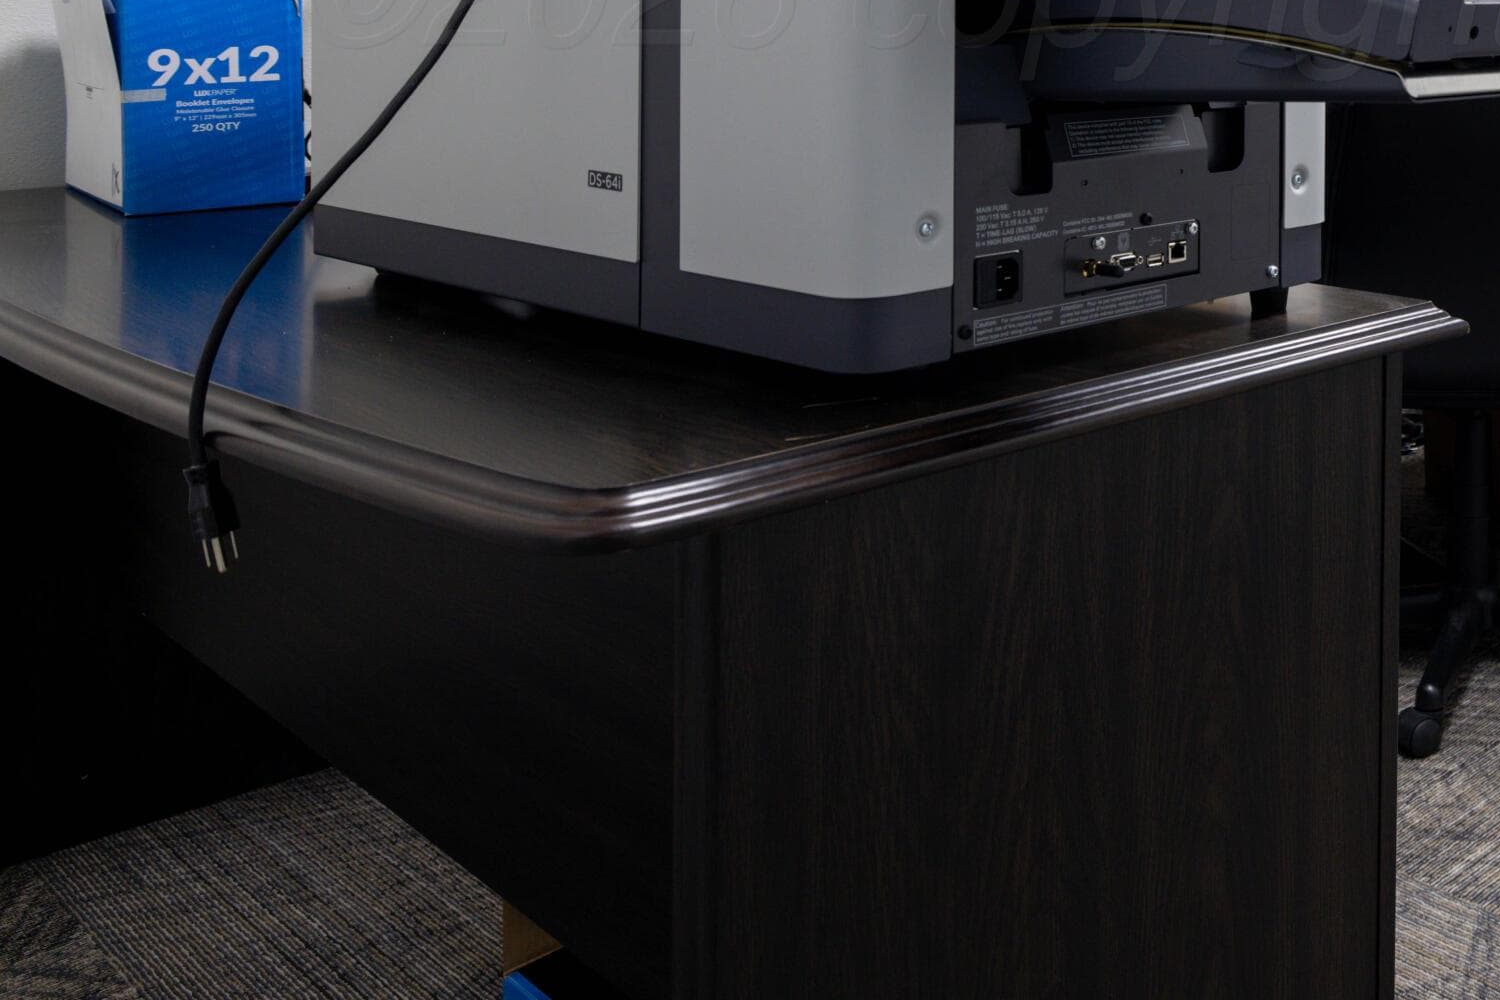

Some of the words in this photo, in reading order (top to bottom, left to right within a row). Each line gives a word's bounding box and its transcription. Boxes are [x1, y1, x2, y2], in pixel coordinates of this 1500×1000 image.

[147, 45, 281, 87] 9x12
[175, 100, 210, 108] Booklet
[211, 97, 255, 106] Envelopes
[191, 123, 214, 133] 250
[215, 121, 241, 132] QTY
[589, 171, 621, 190] DS-64i
